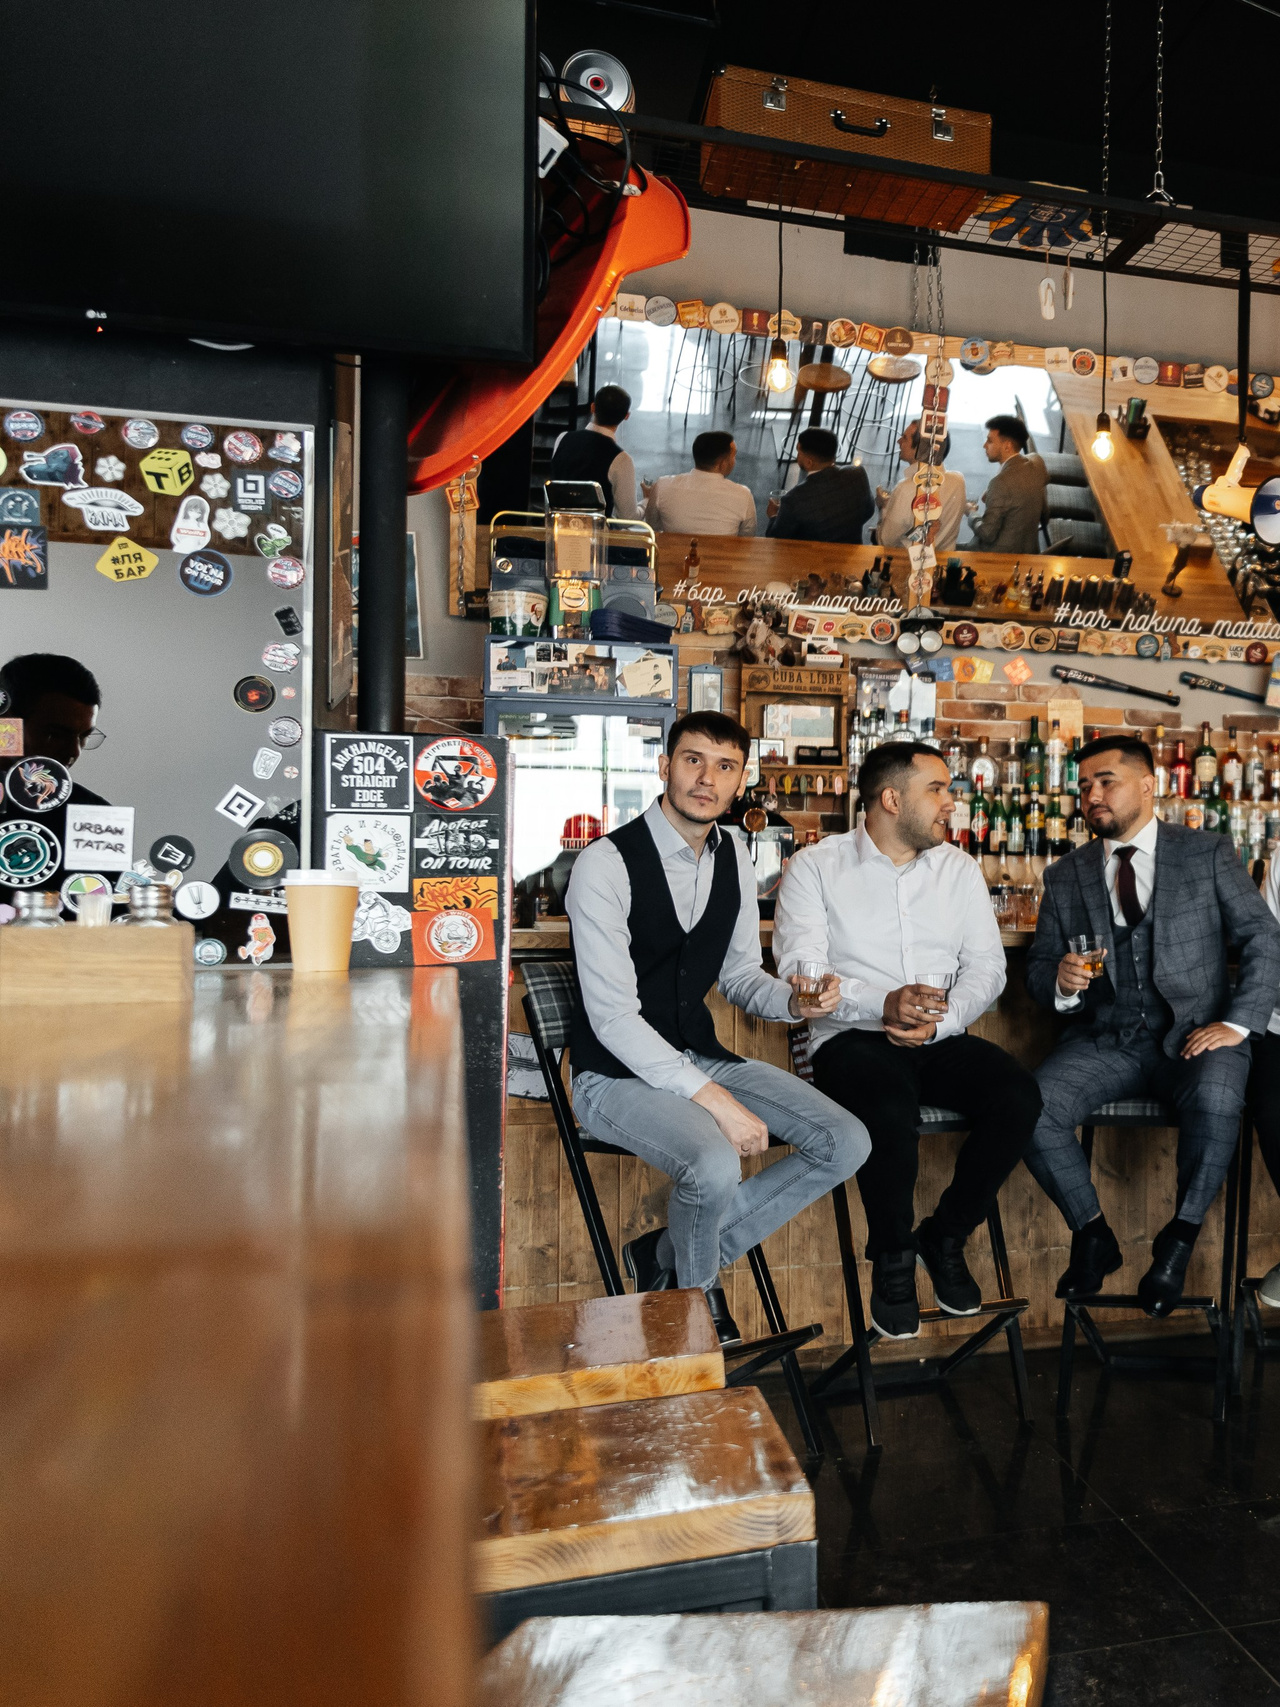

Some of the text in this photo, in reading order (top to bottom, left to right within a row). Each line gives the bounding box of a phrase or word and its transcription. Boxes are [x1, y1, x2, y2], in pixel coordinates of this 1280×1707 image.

[114, 565, 147, 580] БАР
[773, 670, 803, 683] CUBA
[331, 741, 409, 773] ARKHANGELSK
[352, 756, 386, 775] 504
[341, 774, 399, 788] STRAIGHT
[354, 789, 385, 802] EDGE
[73, 822, 125, 836] URBAN
[73, 838, 127, 854] TATAR
[420, 856, 493, 870] ON TOUR
